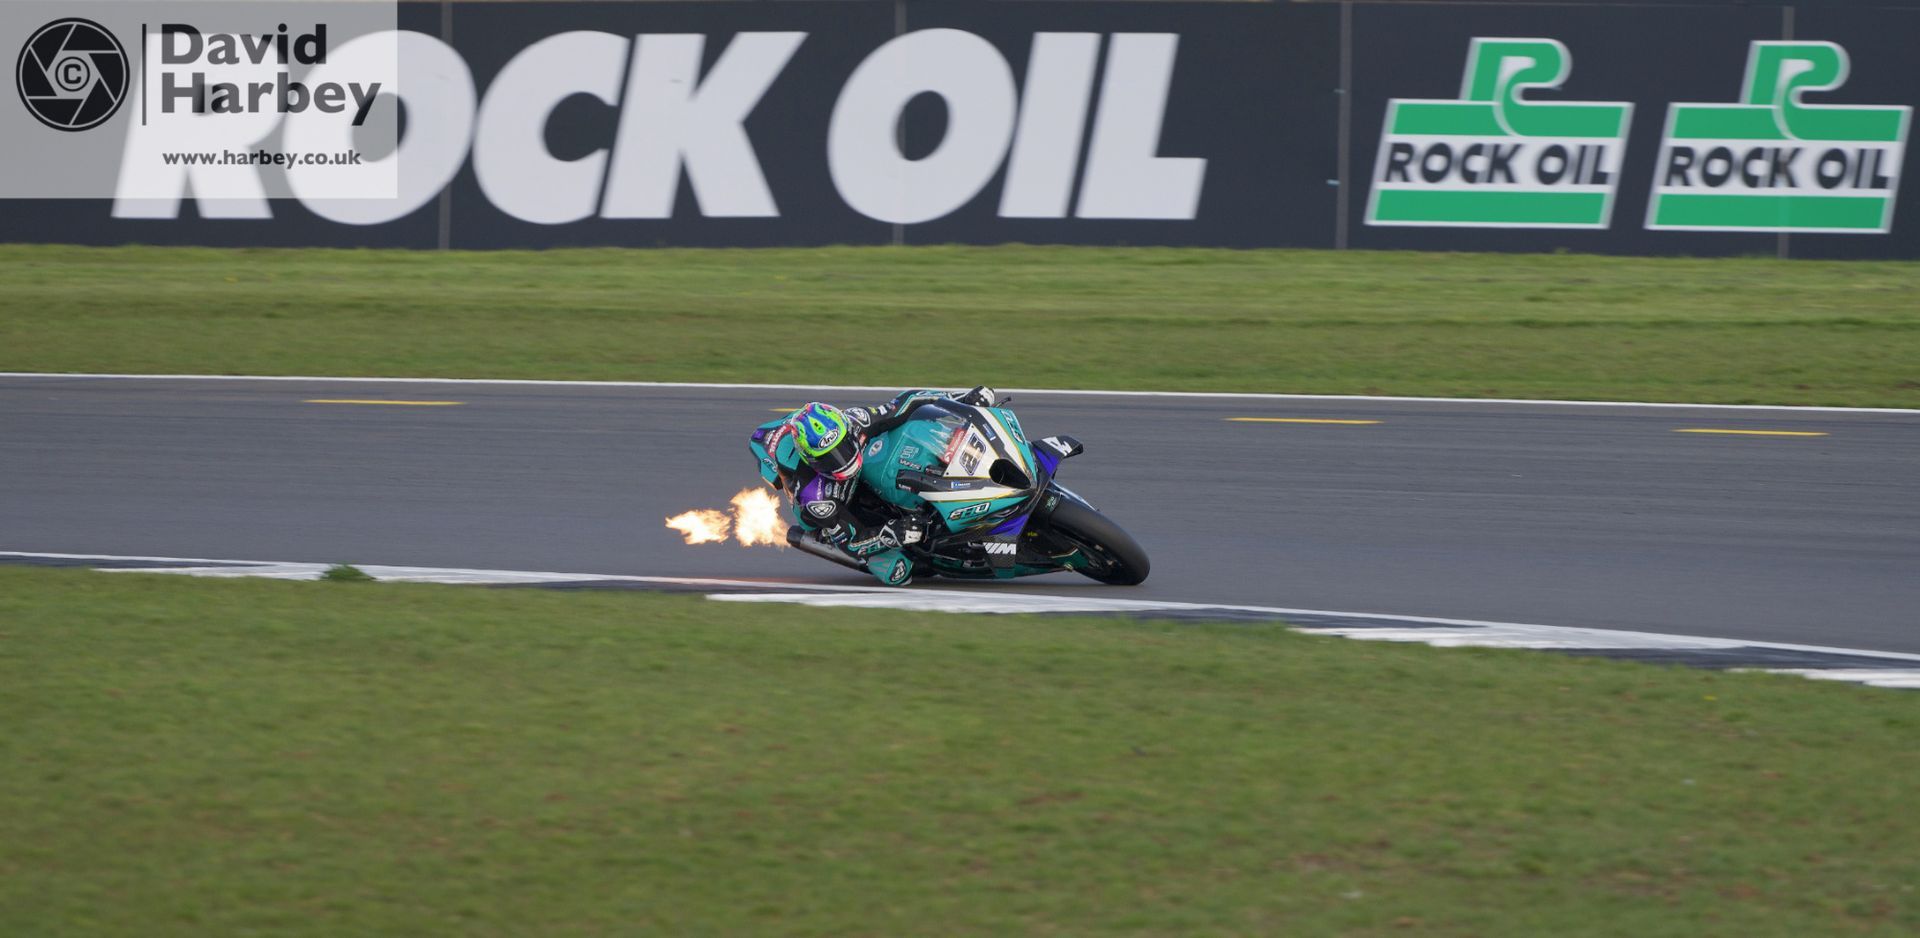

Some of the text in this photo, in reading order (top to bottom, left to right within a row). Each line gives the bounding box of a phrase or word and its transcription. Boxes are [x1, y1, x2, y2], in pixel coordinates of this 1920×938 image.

[110, 28, 1207, 225] ROCK OIL
[1384, 142, 1615, 186] ROCK OIL
[1662, 146, 1896, 190] ROCK OIL
